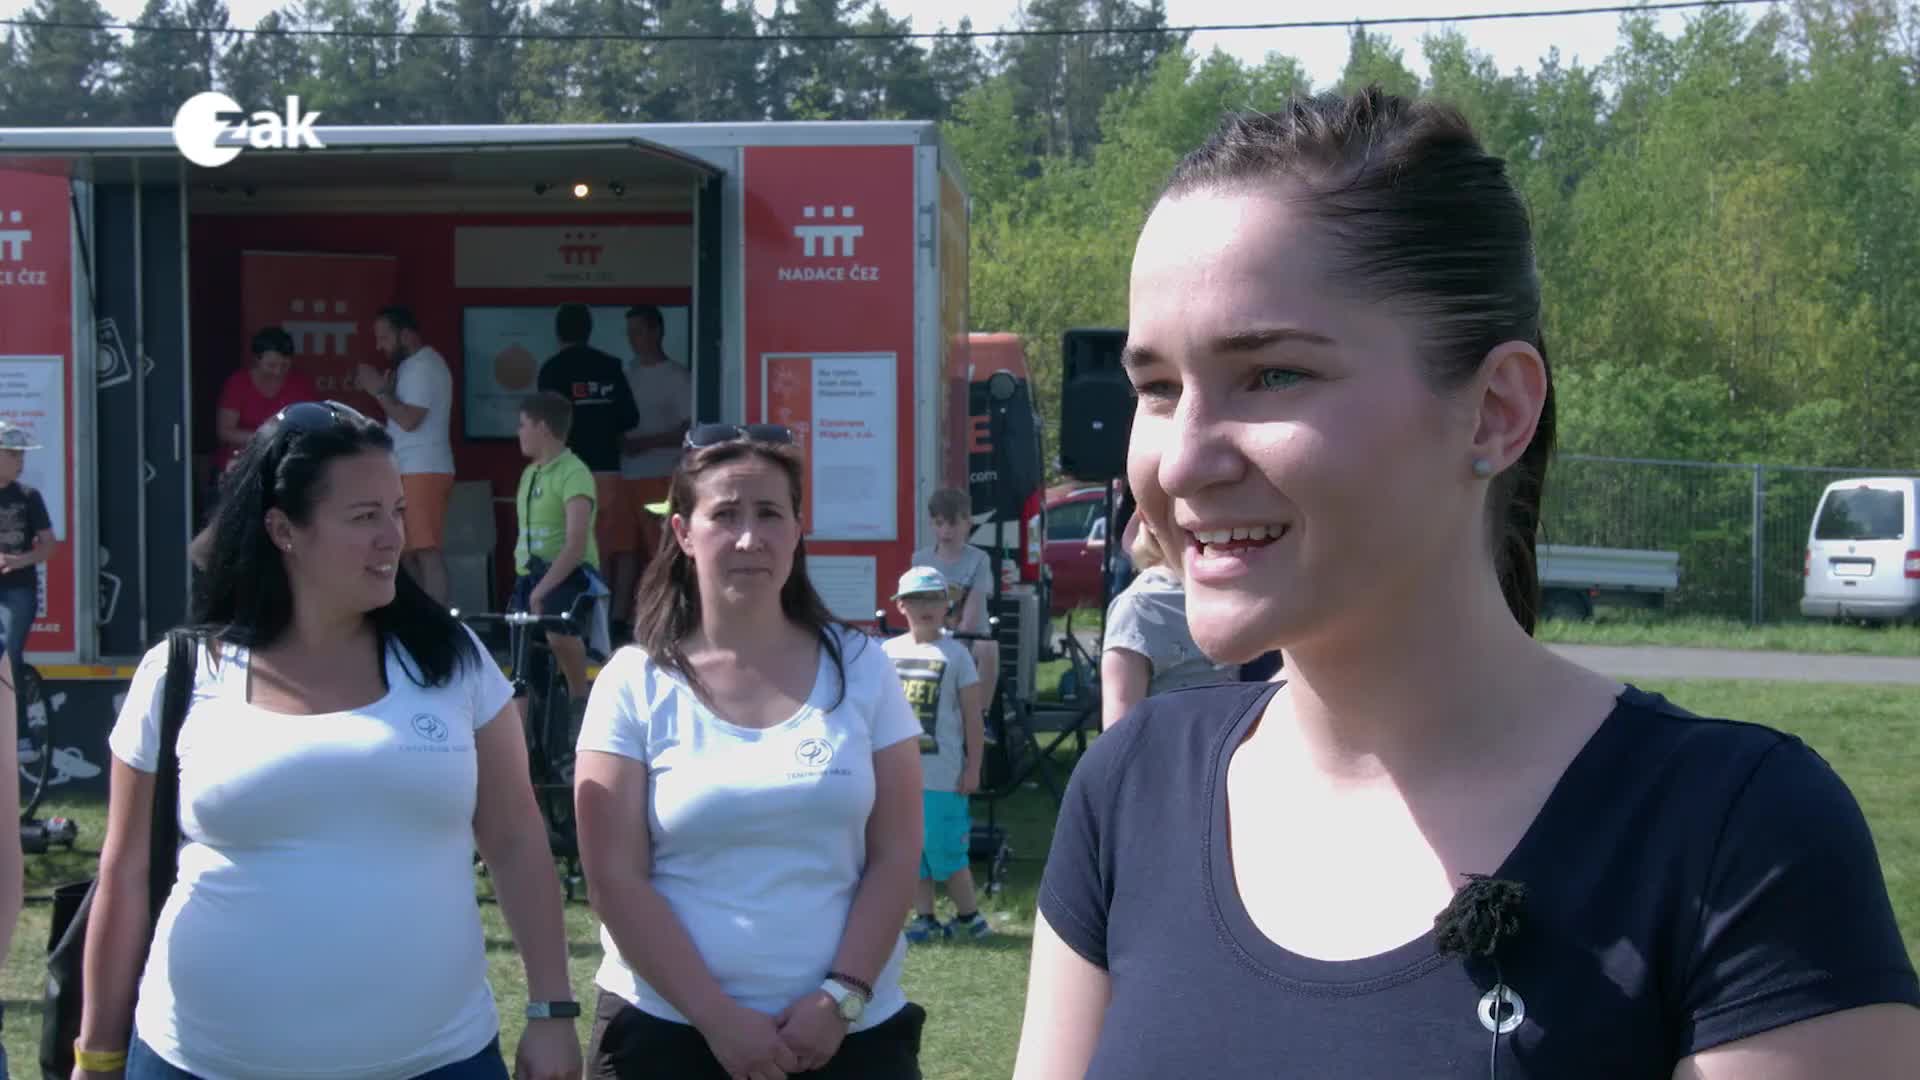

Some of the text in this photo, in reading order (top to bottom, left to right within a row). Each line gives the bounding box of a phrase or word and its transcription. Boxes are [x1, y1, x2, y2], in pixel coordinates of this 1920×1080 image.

[17, 267, 47, 285] ČEZ
[778, 262, 880, 281] NADACE ČEZ
